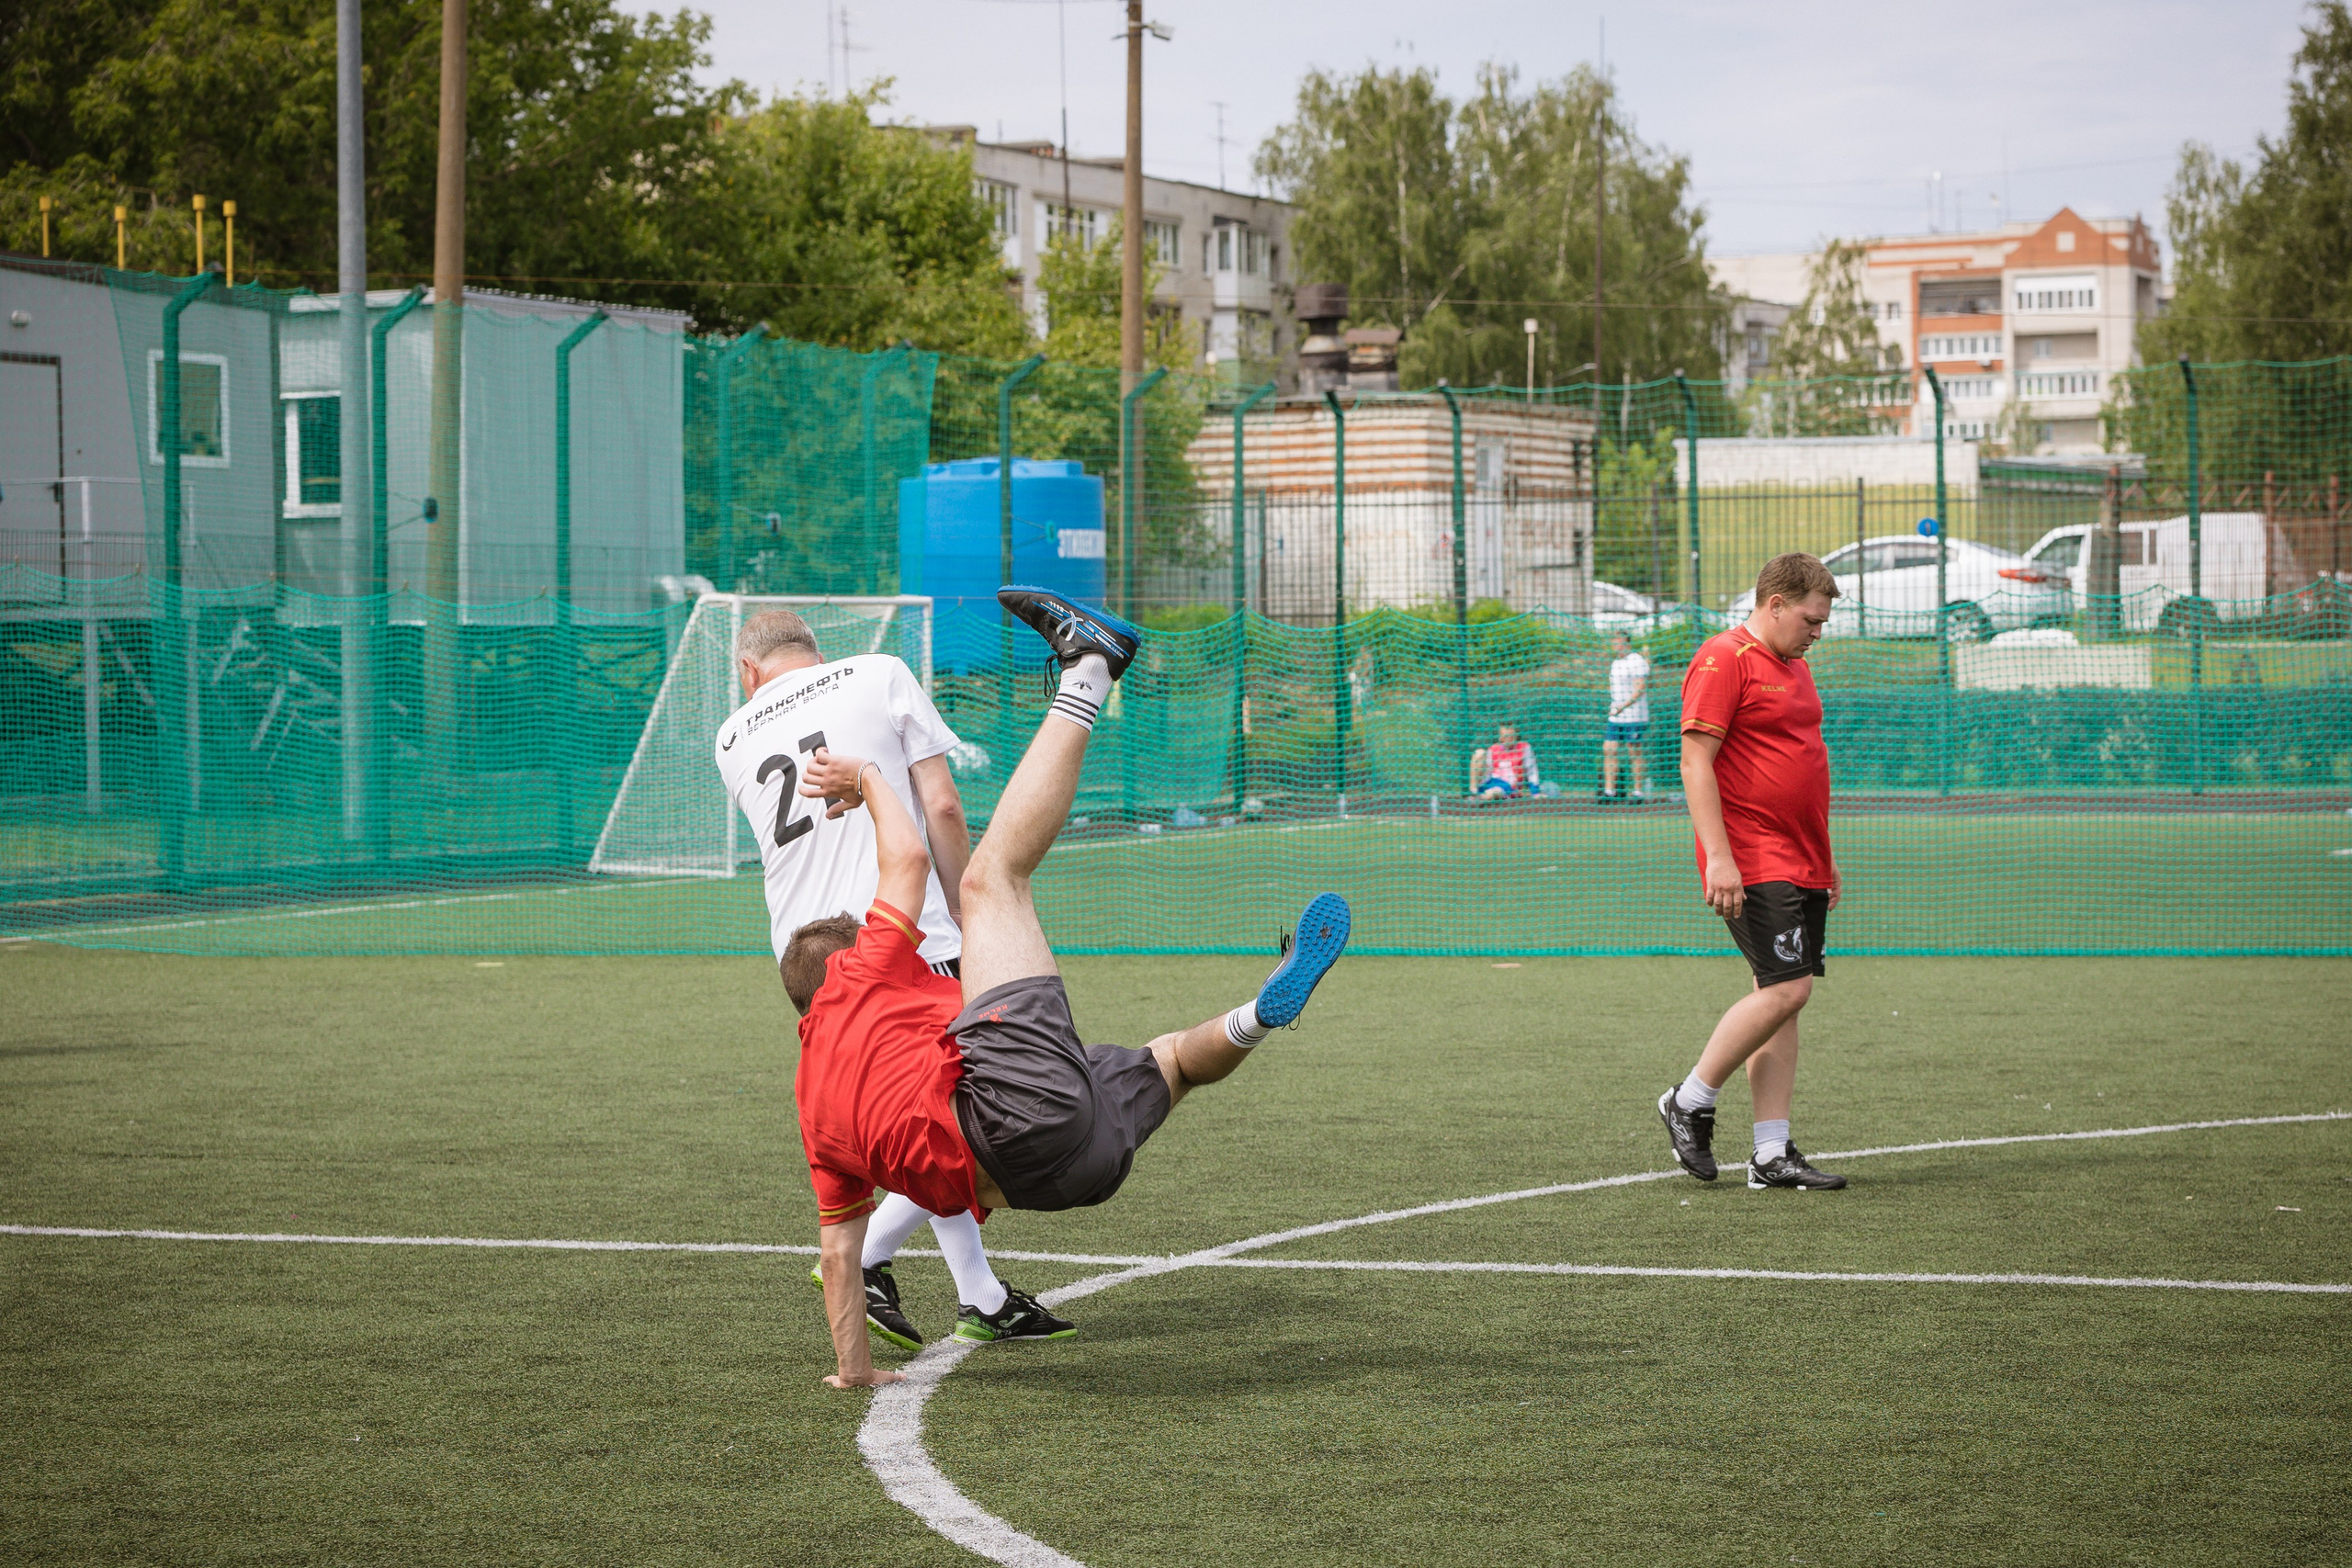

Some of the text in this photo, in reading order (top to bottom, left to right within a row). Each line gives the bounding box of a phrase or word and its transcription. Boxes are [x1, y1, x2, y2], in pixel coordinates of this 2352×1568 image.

[746, 667, 854, 727] ТРАНСНЕФТЬ
[747, 682, 840, 736] ВЕРХНЯЯ ВОЛГА
[978, 1004, 1008, 1020] KELME
